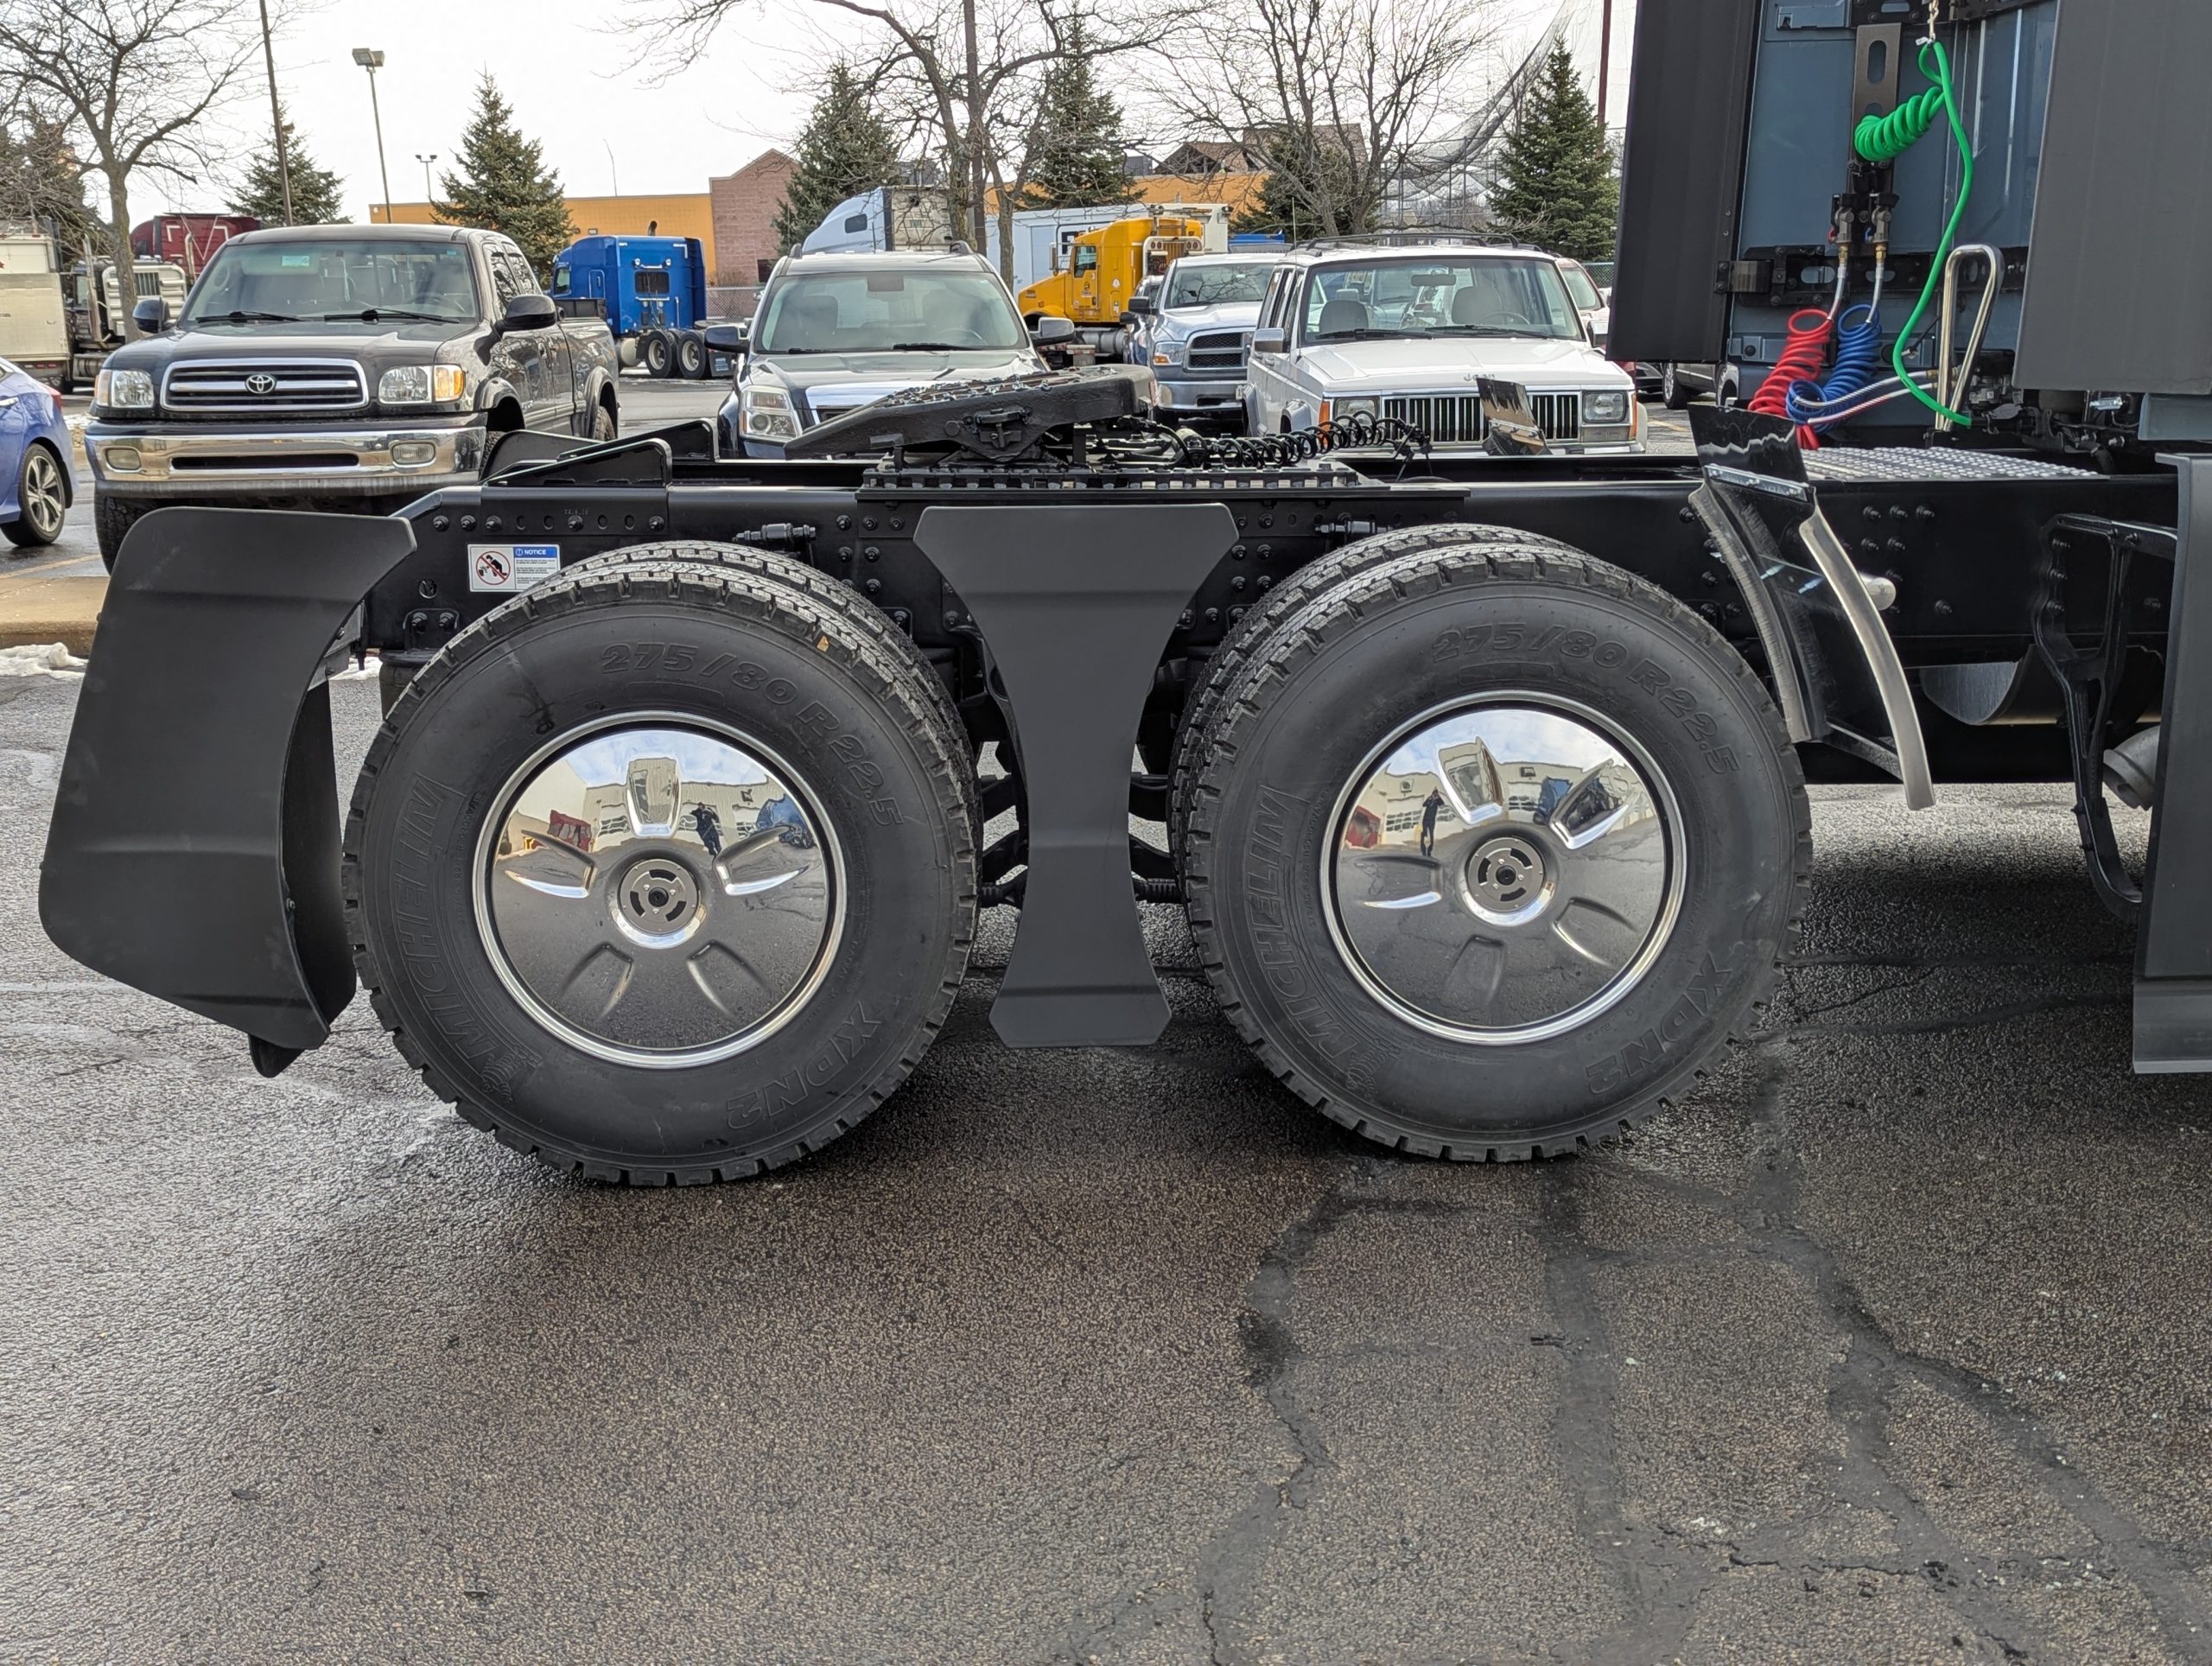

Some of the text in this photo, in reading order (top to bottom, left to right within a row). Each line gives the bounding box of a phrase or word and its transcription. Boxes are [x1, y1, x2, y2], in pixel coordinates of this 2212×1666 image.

[601, 643, 799, 705] 275/80
[1431, 622, 1628, 669] 275/80
[395, 779, 498, 1060] MICHELIN
[1246, 791, 1359, 1059] MICHELIN
[726, 1001, 881, 1129] XDN2
[1585, 951, 1732, 1096] XDN2
